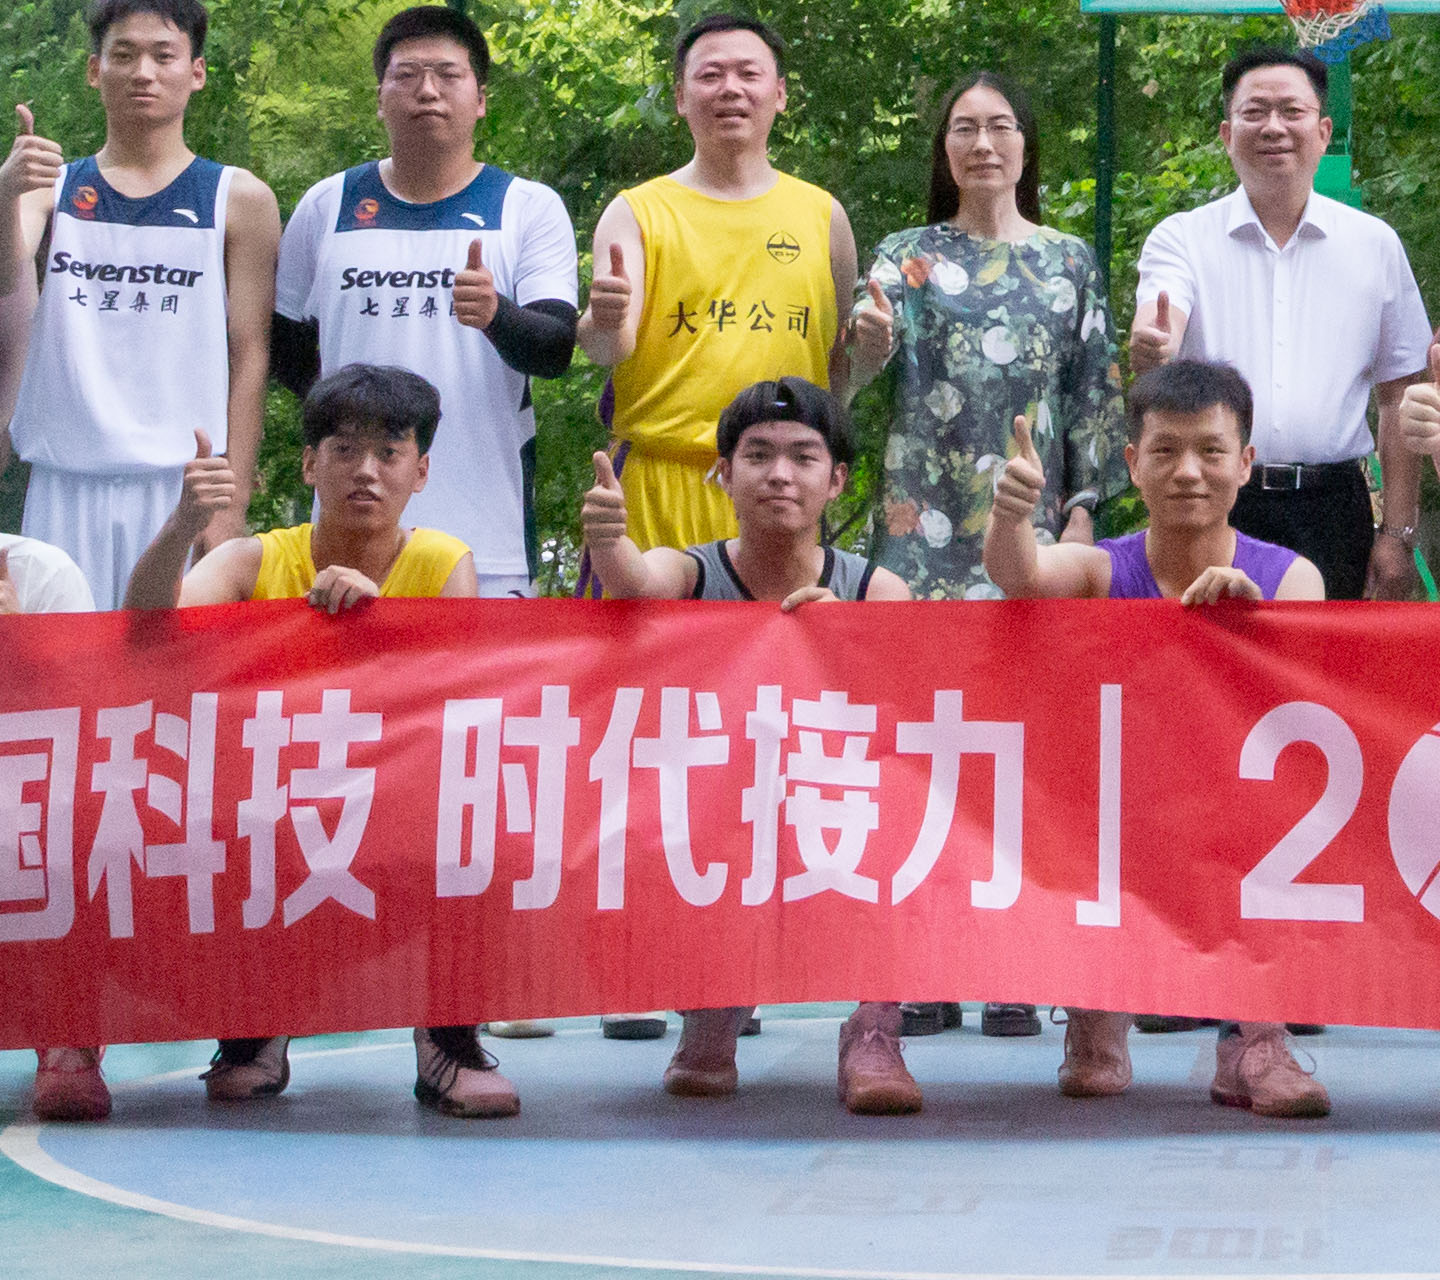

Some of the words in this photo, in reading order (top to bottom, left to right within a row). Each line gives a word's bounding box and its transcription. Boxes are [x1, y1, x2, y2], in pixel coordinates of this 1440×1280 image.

[50, 251, 203, 288] Sevenstar
[340, 267, 456, 290] Sevenst
[68, 287, 179, 315] 七星集团
[668, 299, 810, 339] 大华公司
